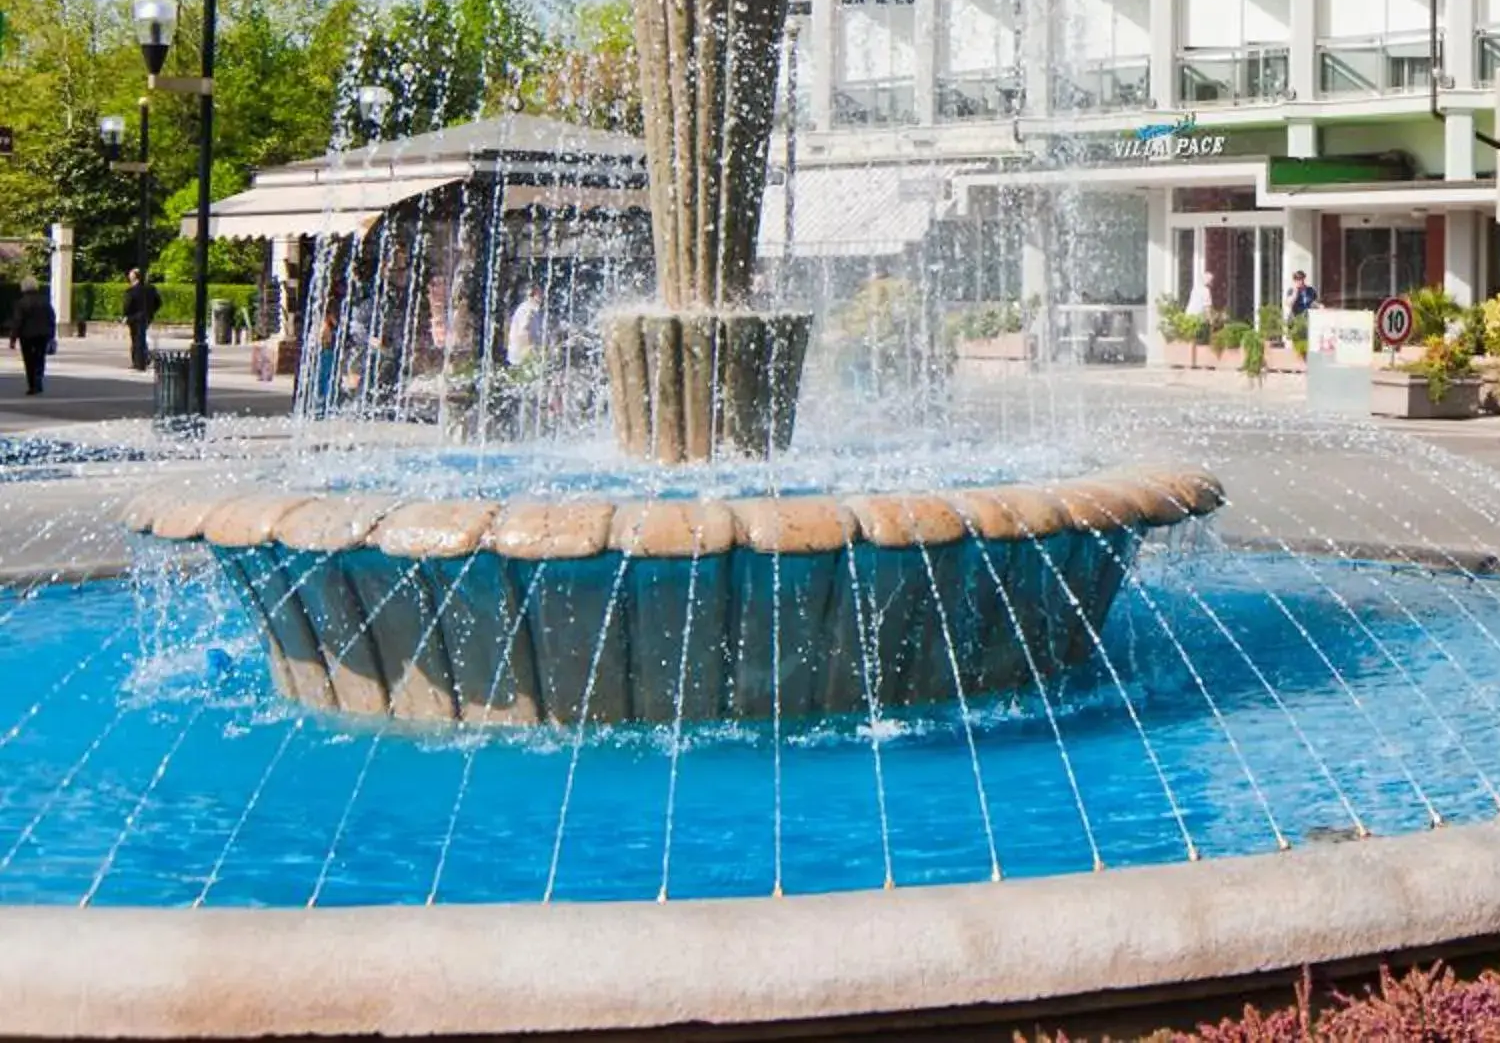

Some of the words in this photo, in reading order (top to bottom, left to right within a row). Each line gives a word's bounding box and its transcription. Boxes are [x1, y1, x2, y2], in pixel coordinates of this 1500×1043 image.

[1113, 137, 1170, 158] VILLA
[1175, 135, 1225, 156] PACE
[1387, 309, 1405, 334] 10
